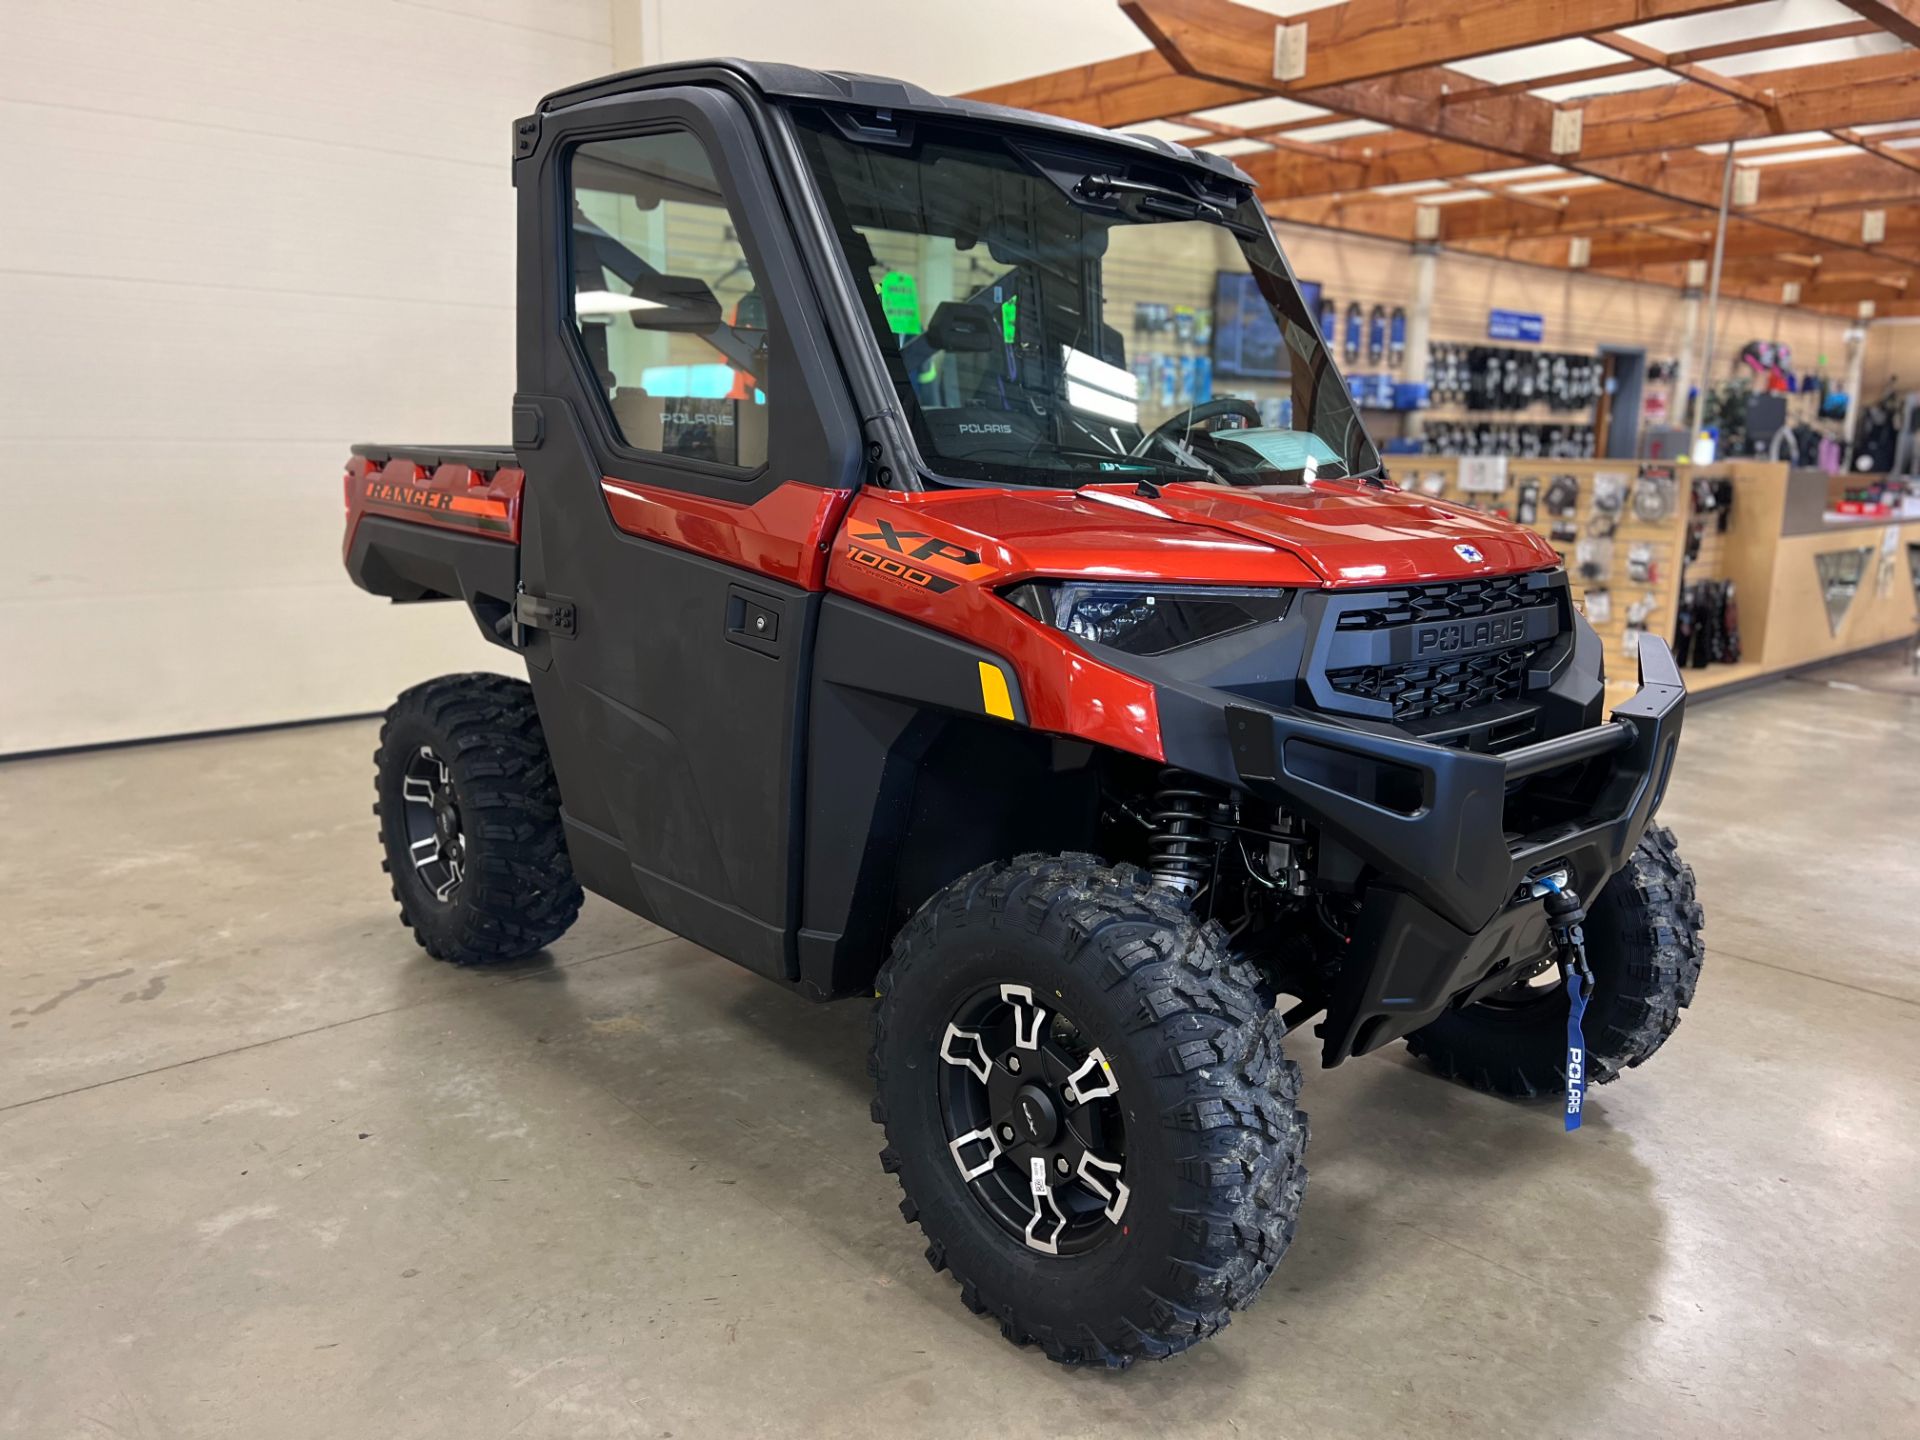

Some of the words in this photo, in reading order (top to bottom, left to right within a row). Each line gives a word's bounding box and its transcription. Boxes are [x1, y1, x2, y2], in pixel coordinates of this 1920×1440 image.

[659, 413, 734, 426] POLARIS
[959, 424, 1012, 434] POLARIS
[366, 483, 453, 510] RANGER
[851, 518, 981, 566] XP
[846, 547, 933, 587] 1000
[1418, 616, 1525, 656] POLARIS
[1567, 1047, 1582, 1114] POLARIS
